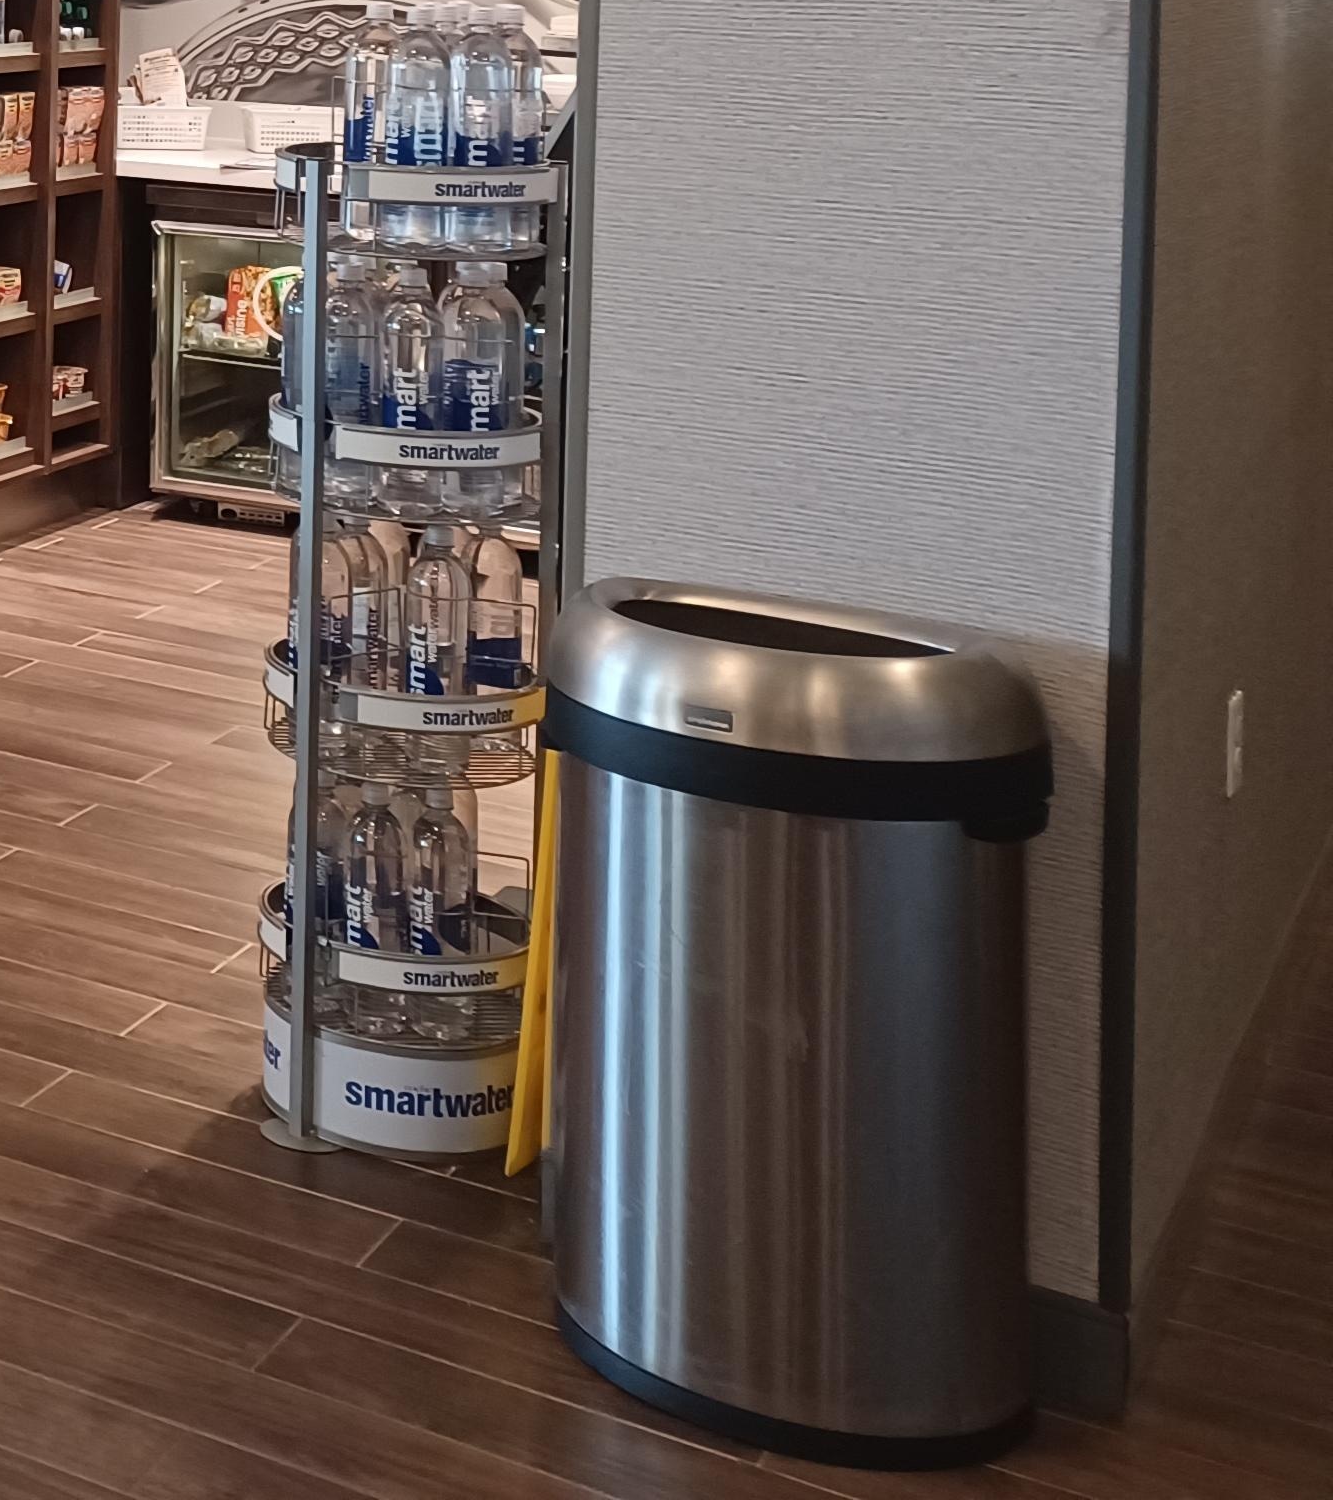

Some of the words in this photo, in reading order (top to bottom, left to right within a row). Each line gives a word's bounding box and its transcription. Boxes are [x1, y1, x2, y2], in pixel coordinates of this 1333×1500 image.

[435, 181, 526, 198] smartwater
[394, 368, 417, 431] mart
[467, 369, 490, 432] mart
[399, 444, 501, 461] smartwater
[422, 707, 514, 726] smartwater
[345, 883, 362, 947] mart
[403, 969, 499, 987] smartwater
[345, 1080, 515, 1118] smartwater
